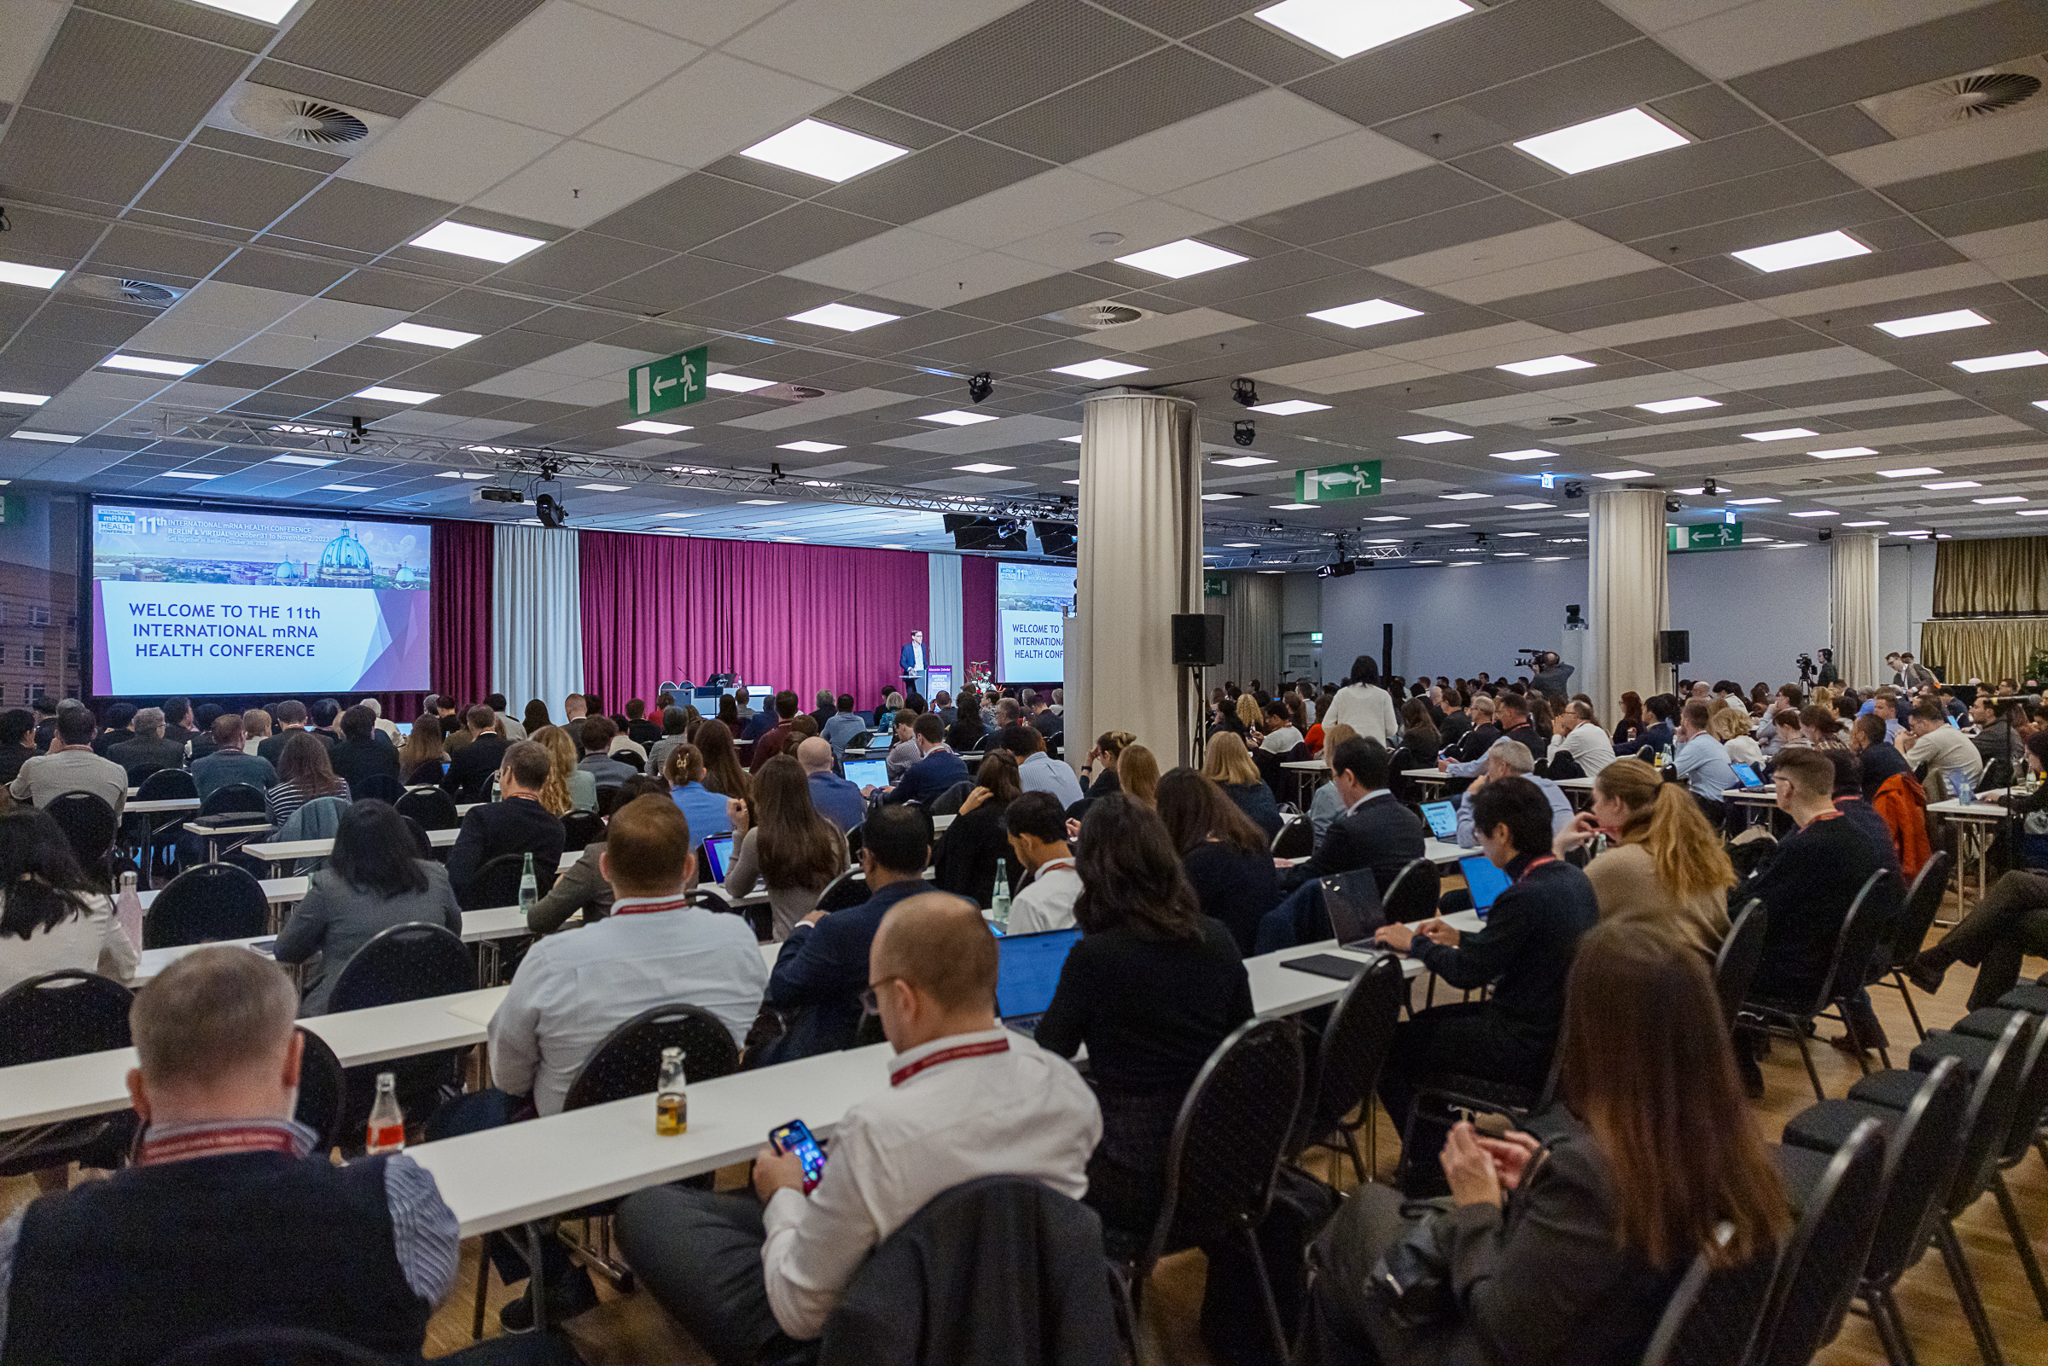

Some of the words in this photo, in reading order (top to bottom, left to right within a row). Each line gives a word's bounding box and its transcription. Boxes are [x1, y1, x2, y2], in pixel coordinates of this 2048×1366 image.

[138, 516, 167, 534] 11th
[168, 519, 222, 529] INTERNATIONAL
[270, 525, 312, 534] CONFERENCE
[200, 529, 229, 537] VIRTUAL
[235, 531, 259, 539] October
[129, 603, 215, 618] WELCOME
[221, 605, 243, 618] TO
[248, 606, 280, 619] THE
[286, 606, 321, 620] 11th
[133, 624, 267, 638] INTERNATIONAL
[272, 625, 319, 638] mRNA
[1012, 624, 1048, 634] WELCOME
[1050, 624, 1060, 634] TO
[1013, 637, 1064, 646] INTERNATIONA
[135, 644, 204, 657] HEALTH
[209, 644, 315, 657] CONFERENCE
[1014, 650, 1043, 659] HEALTH
[1044, 650, 1064, 659] CONF
